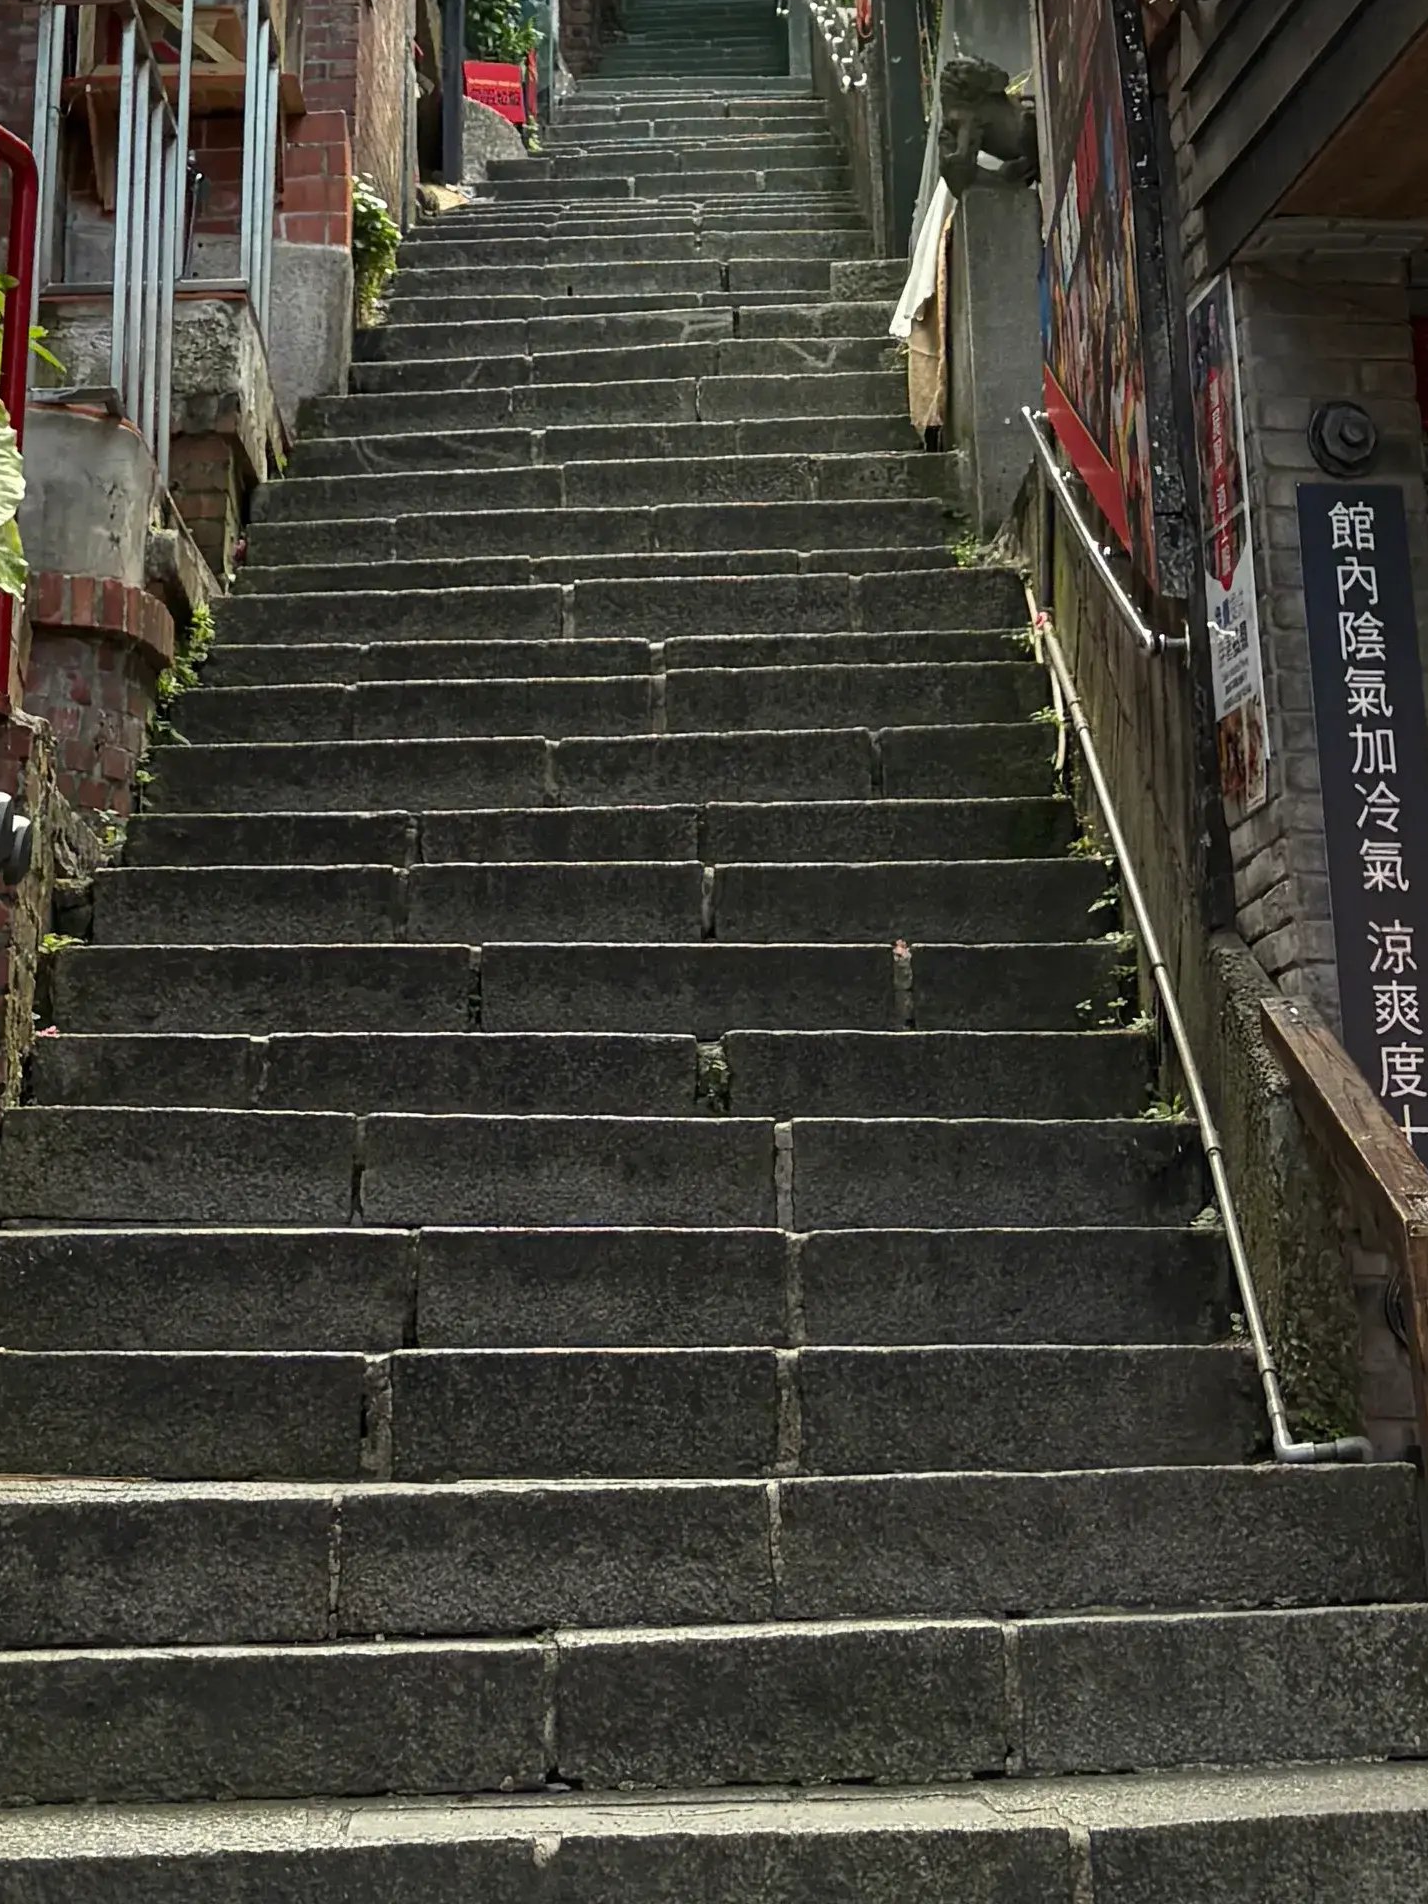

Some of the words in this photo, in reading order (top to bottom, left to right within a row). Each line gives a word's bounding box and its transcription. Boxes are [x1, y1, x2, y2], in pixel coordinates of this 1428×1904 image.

[1326, 497, 1412, 896] 館內陰氣加冷氣
